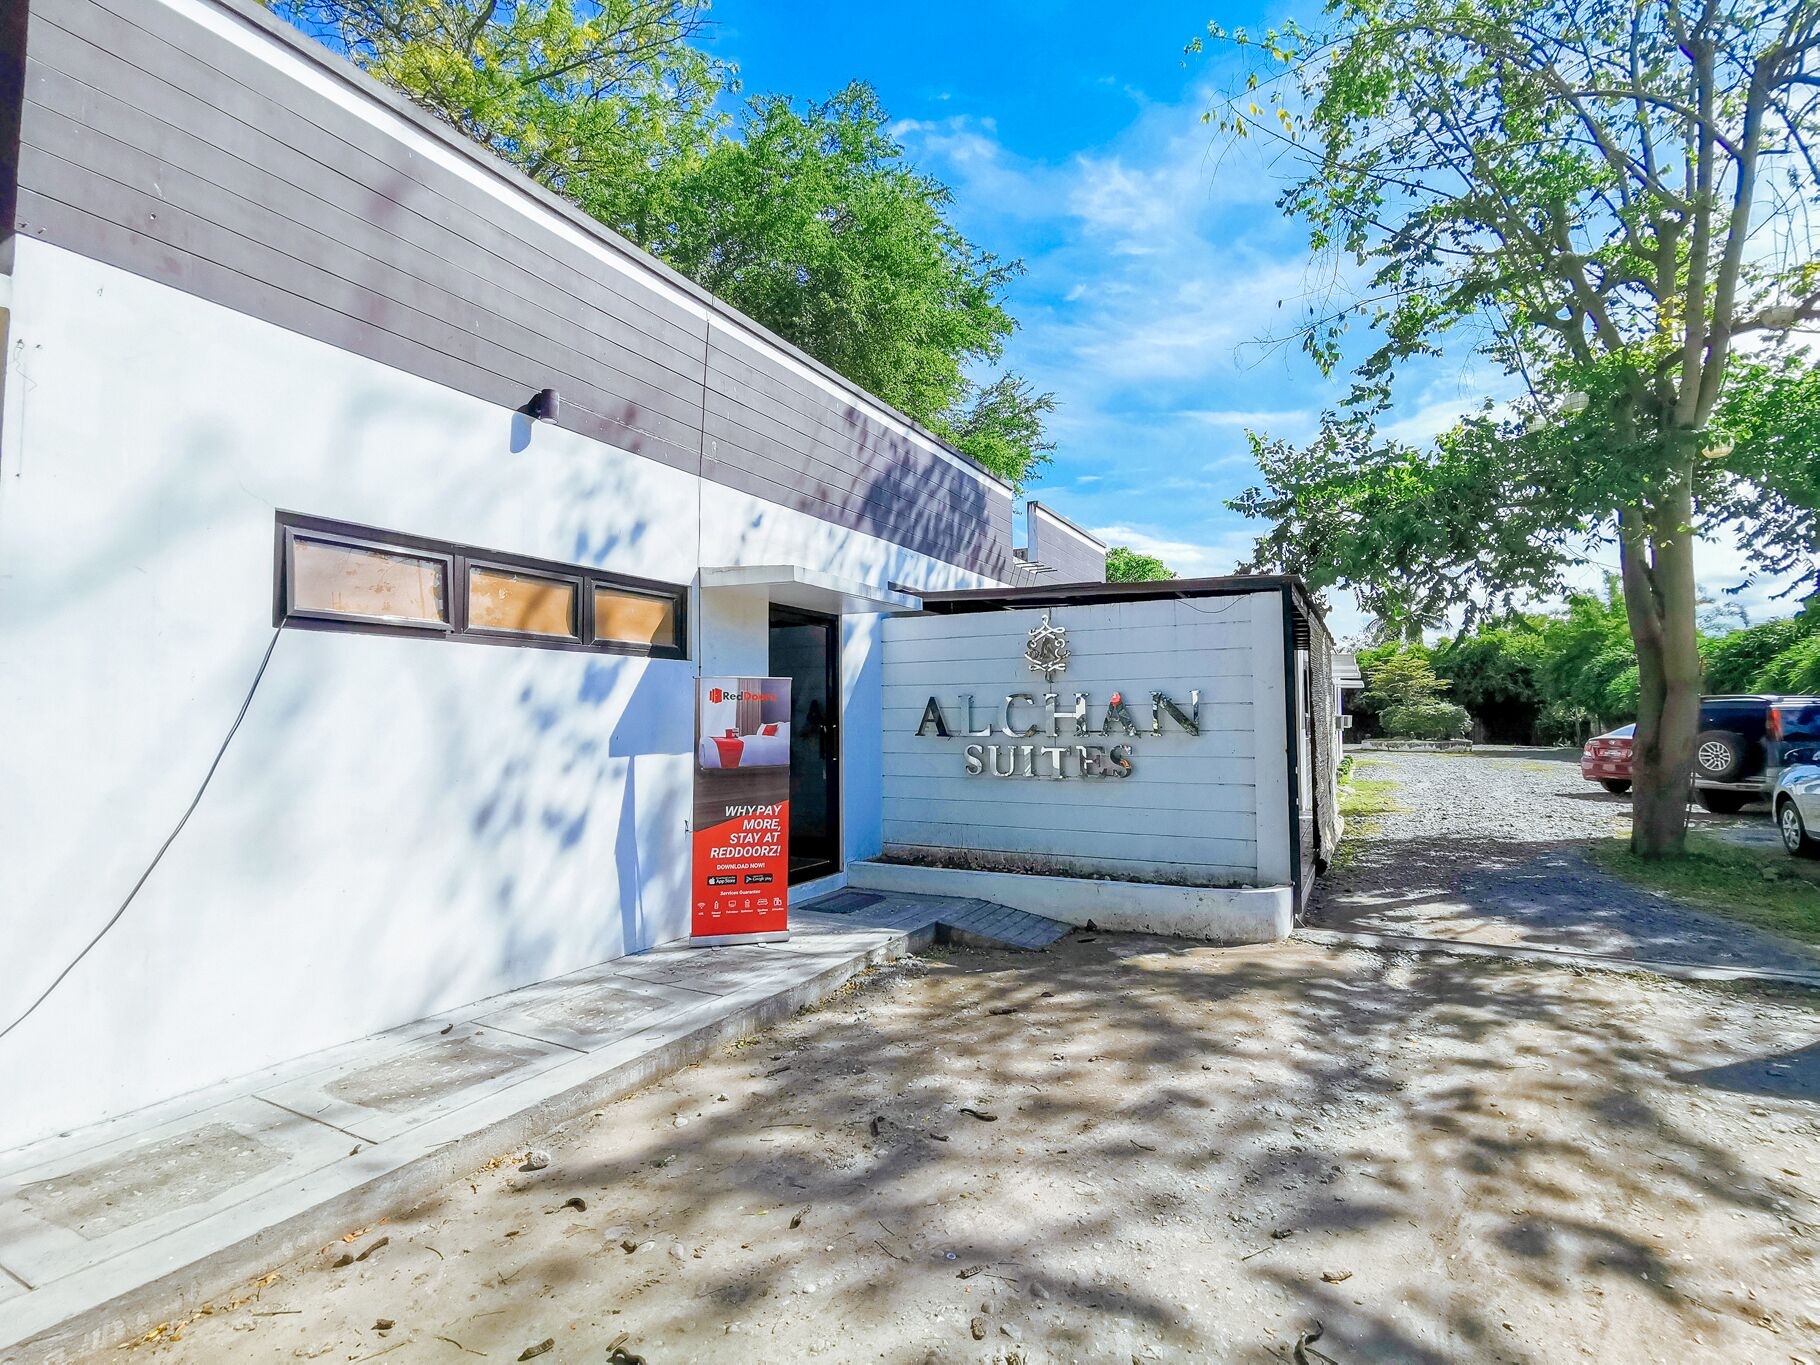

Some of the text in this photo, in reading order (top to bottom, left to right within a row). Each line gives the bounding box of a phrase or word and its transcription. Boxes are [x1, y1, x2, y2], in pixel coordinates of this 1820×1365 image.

[914, 689, 1200, 737] ALCHAN
[963, 744, 1133, 778] SUITES
[725, 804, 782, 817] WHY PAY
[742, 818, 781, 831] MORE,
[729, 832, 780, 844] STAY AT
[710, 845, 781, 858] REDDOORZ!
